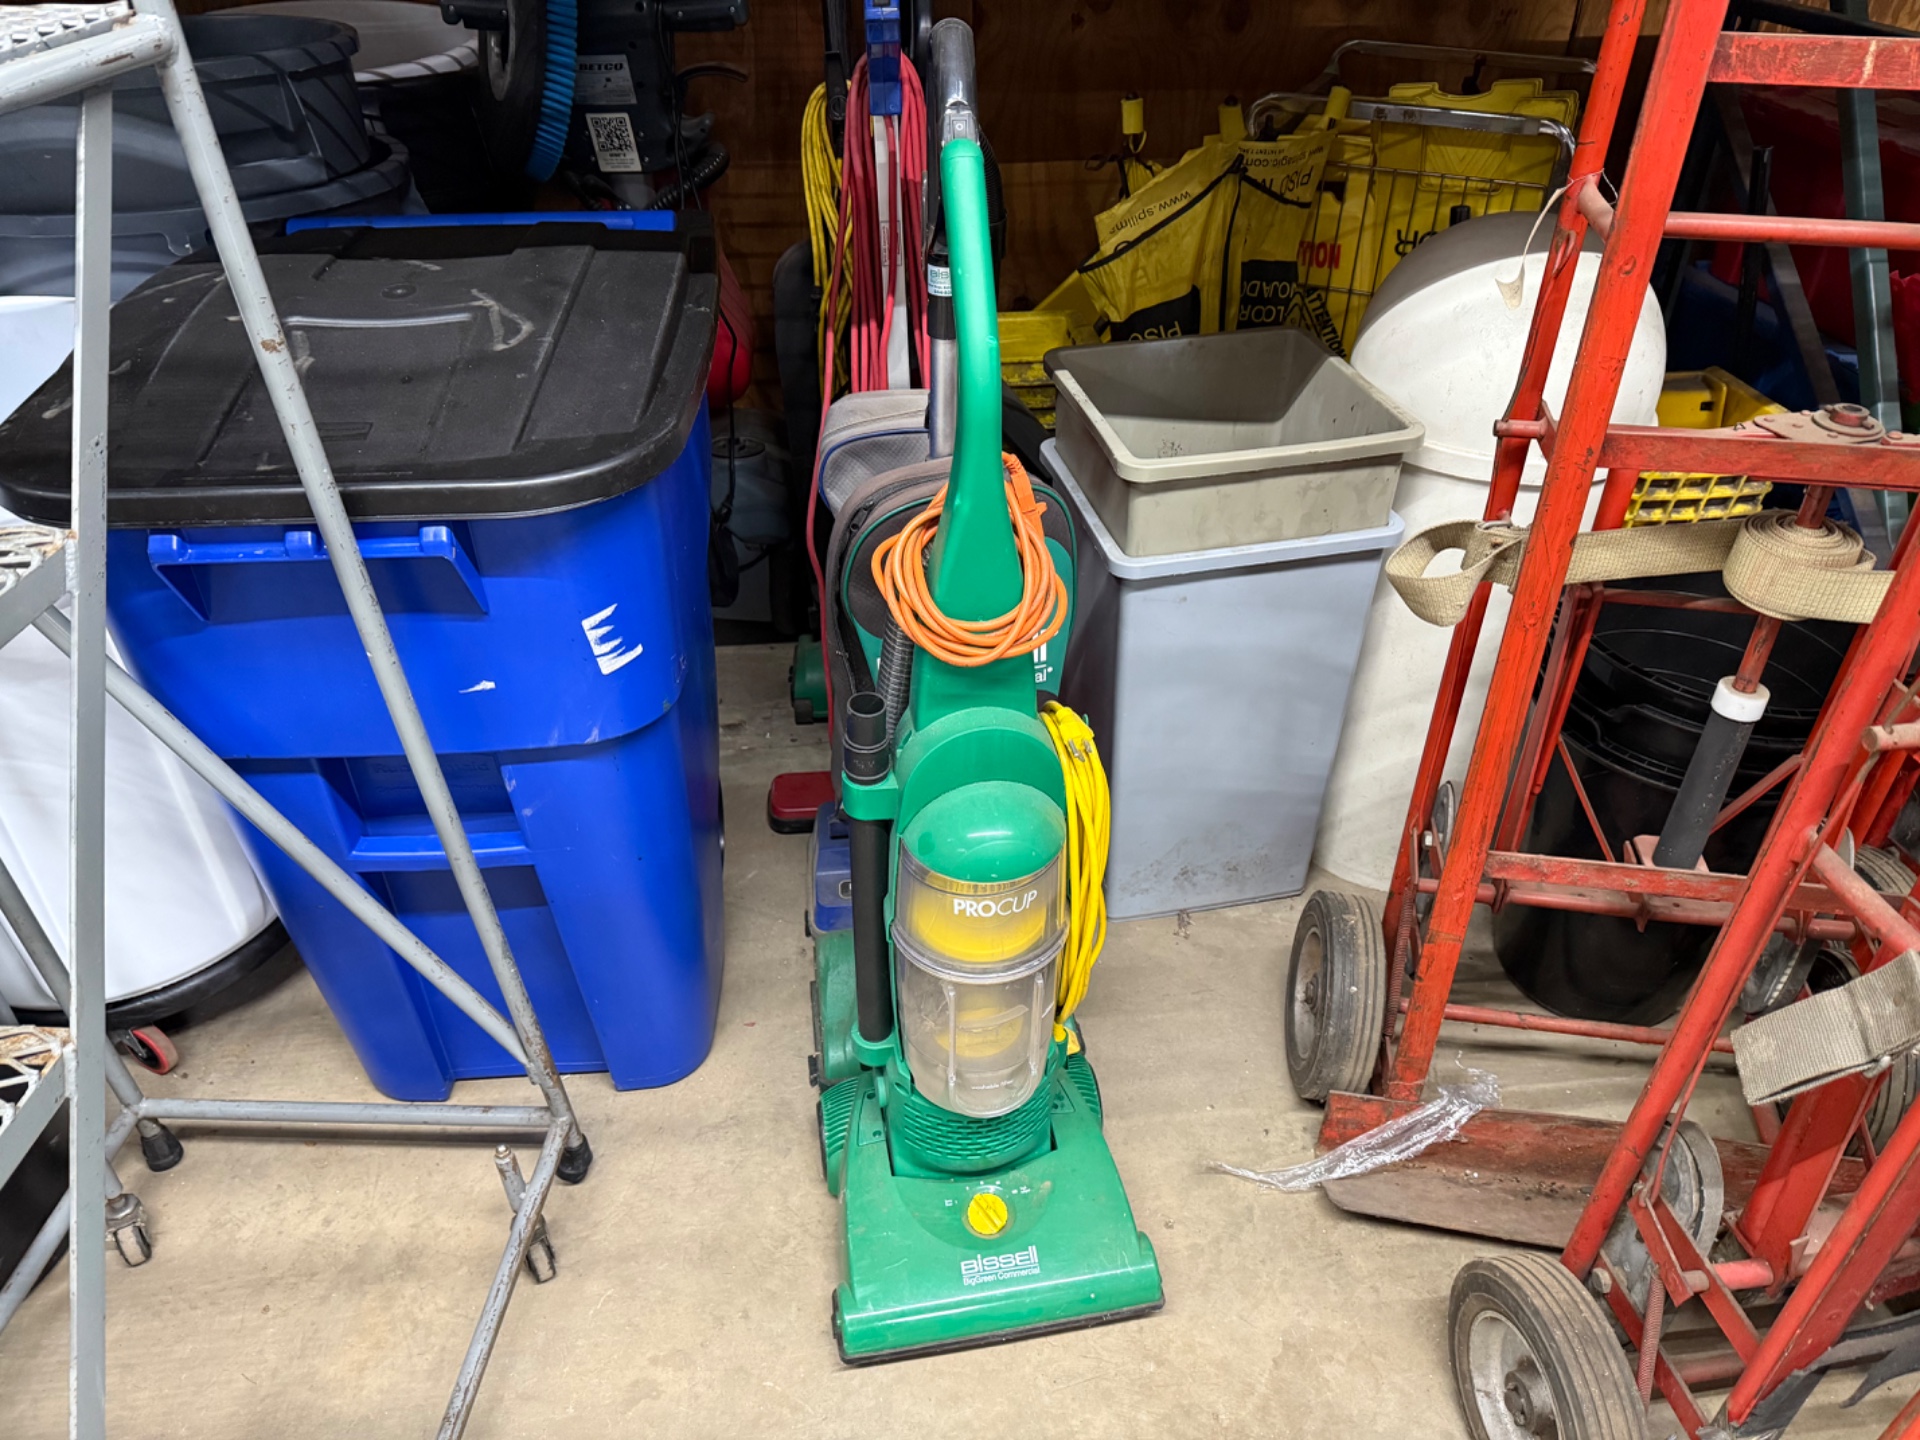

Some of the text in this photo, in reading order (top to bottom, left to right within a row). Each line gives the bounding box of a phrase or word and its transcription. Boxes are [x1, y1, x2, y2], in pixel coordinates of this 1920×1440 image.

[579, 62, 623, 71] BETCO
[1298, 240, 1342, 269] TION
[1239, 304, 1285, 323] LOOR
[953, 889, 1038, 918] PROCUP
[963, 1265, 1040, 1286] BigGreen Commercial
